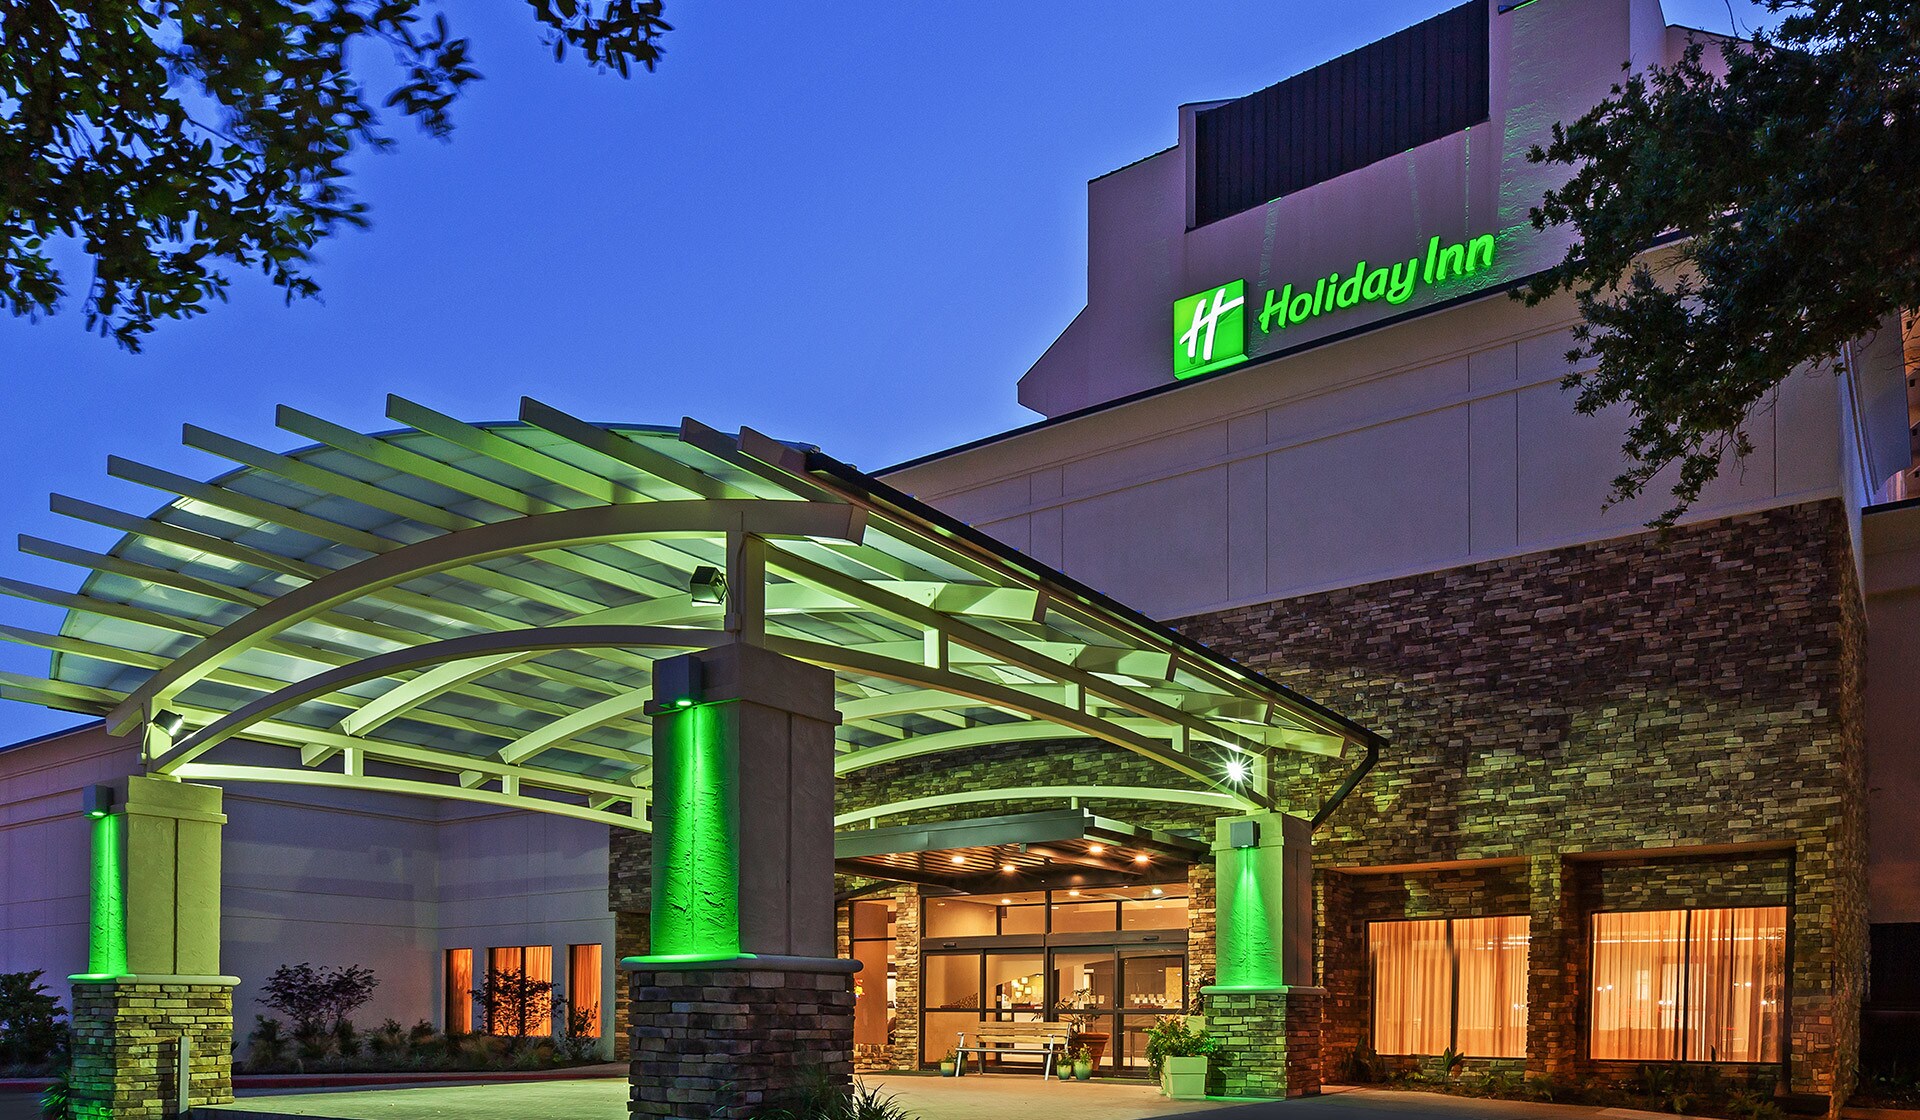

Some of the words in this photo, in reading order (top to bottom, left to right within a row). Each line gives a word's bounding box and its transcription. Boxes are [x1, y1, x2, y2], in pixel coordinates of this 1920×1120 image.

[1179, 287, 1245, 361] H
[1258, 258, 1419, 333] Holiday
[1423, 233, 1496, 284] Inn
